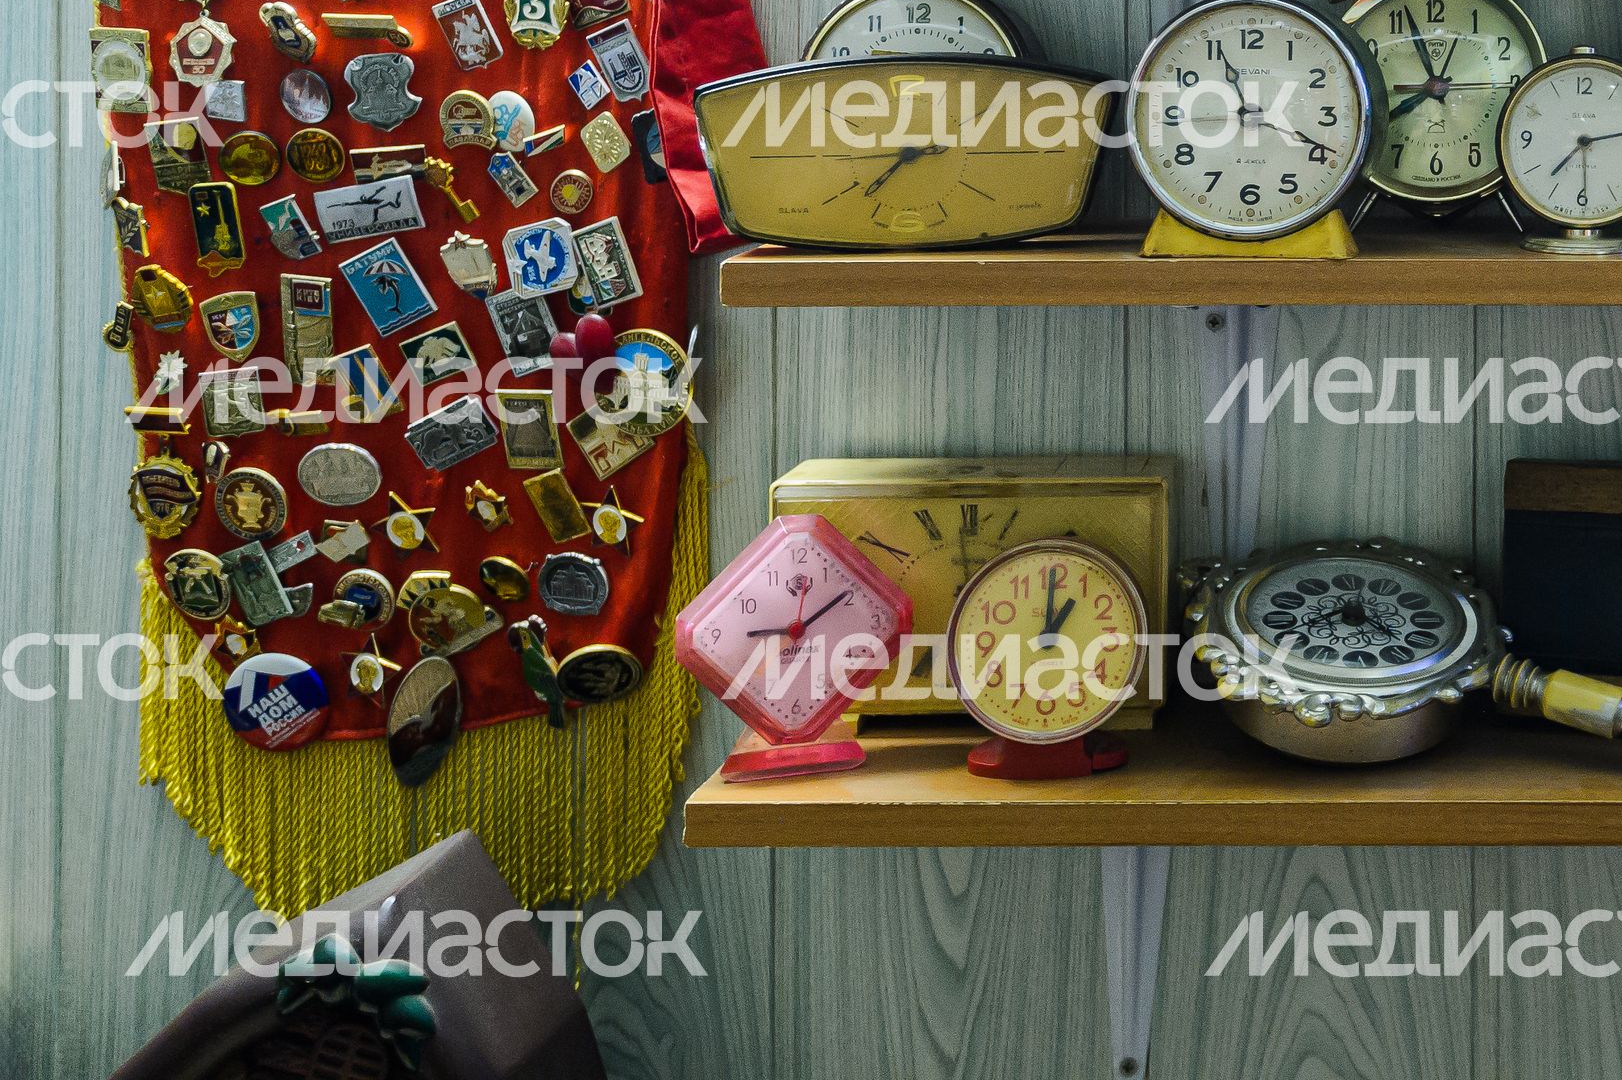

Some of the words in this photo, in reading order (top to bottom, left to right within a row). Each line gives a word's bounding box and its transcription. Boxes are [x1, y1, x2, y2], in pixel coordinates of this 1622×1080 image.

[907, 3, 931, 23] 12
[1426, 0, 1445, 22] 12
[1472, 9, 1478, 34] 1
[868, 16, 882, 32] 11
[1240, 29, 1264, 49] 12
[1498, 37, 1511, 60] 2
[1176, 68, 1199, 88] 10
[1309, 69, 1326, 89] 2
[1577, 77, 1592, 94] 12
[1318, 106, 1337, 127] 3
[1430, 151, 1443, 175] 6
[1468, 143, 1481, 167] 5
[1279, 173, 1299, 194] 5
[1239, 184, 1261, 205] 6
[346, 244, 395, 274] БАТУМИ
[791, 548, 807, 564] 12
[1009, 575, 1029, 599] 11
[741, 599, 757, 614] 10
[981, 600, 1016, 625] 10
[248, 684, 290, 718] НАШ
[258, 694, 298, 728] ДОМ
